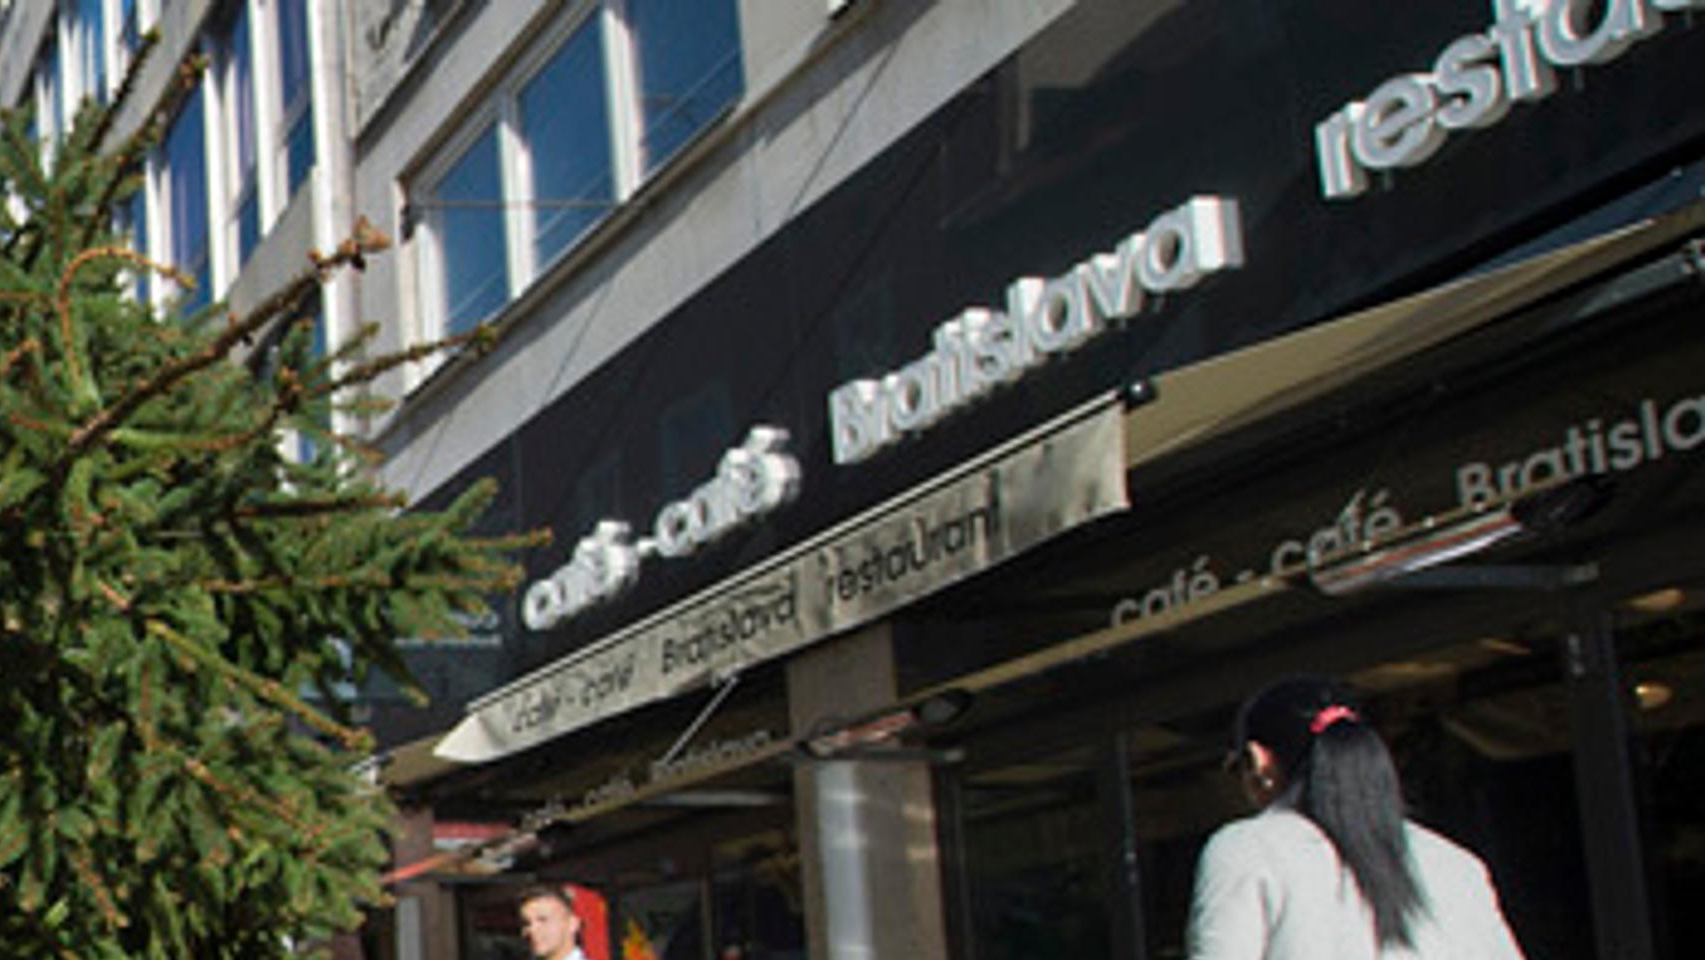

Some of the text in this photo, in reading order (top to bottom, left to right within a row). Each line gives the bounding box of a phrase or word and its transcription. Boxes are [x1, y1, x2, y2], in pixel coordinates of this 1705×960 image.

[829, 195, 1243, 464] Bratislava
[1315, 0, 1705, 197] resta
[1111, 555, 1221, 628] café
[660, 594, 796, 675] Bratislava
